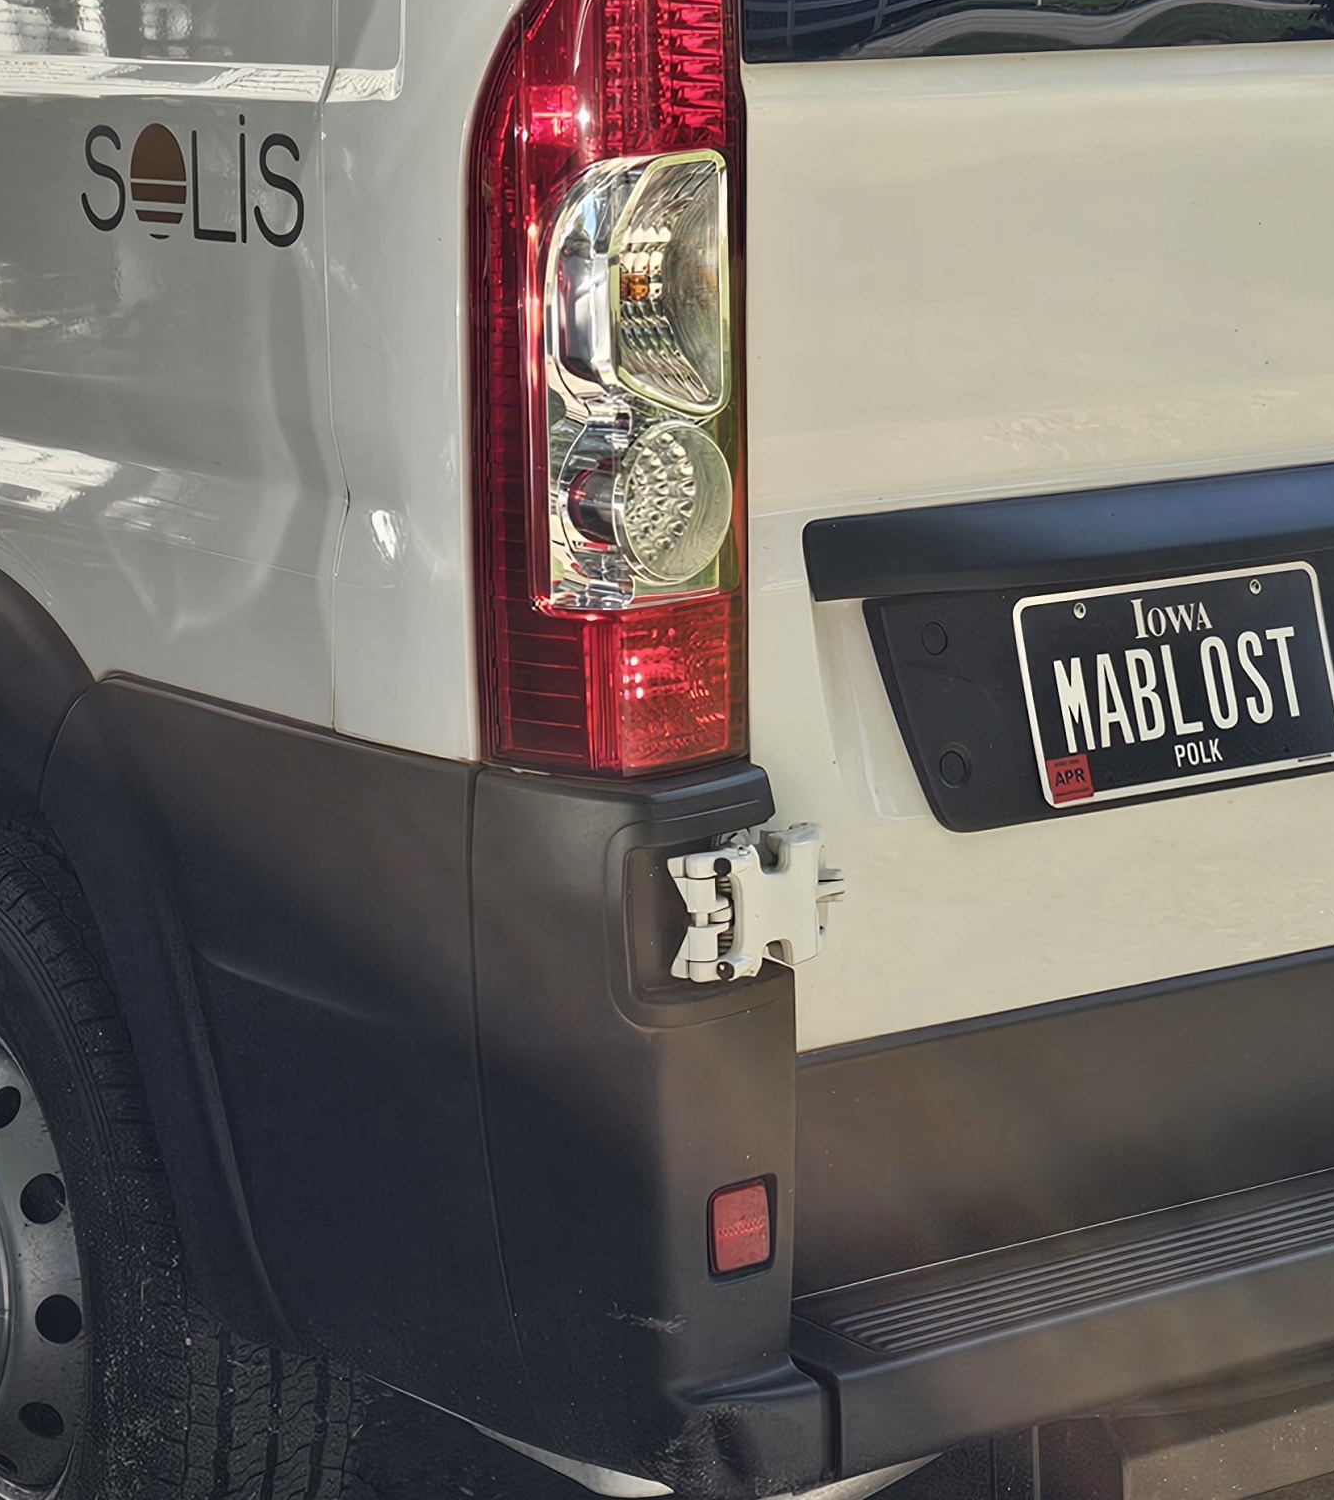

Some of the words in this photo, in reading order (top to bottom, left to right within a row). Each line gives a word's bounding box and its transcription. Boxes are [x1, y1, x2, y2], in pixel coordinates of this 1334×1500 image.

[1053, 626, 1300, 754] MABLOST
[1174, 738, 1223, 767] POLK
[1055, 768, 1086, 787] APR
